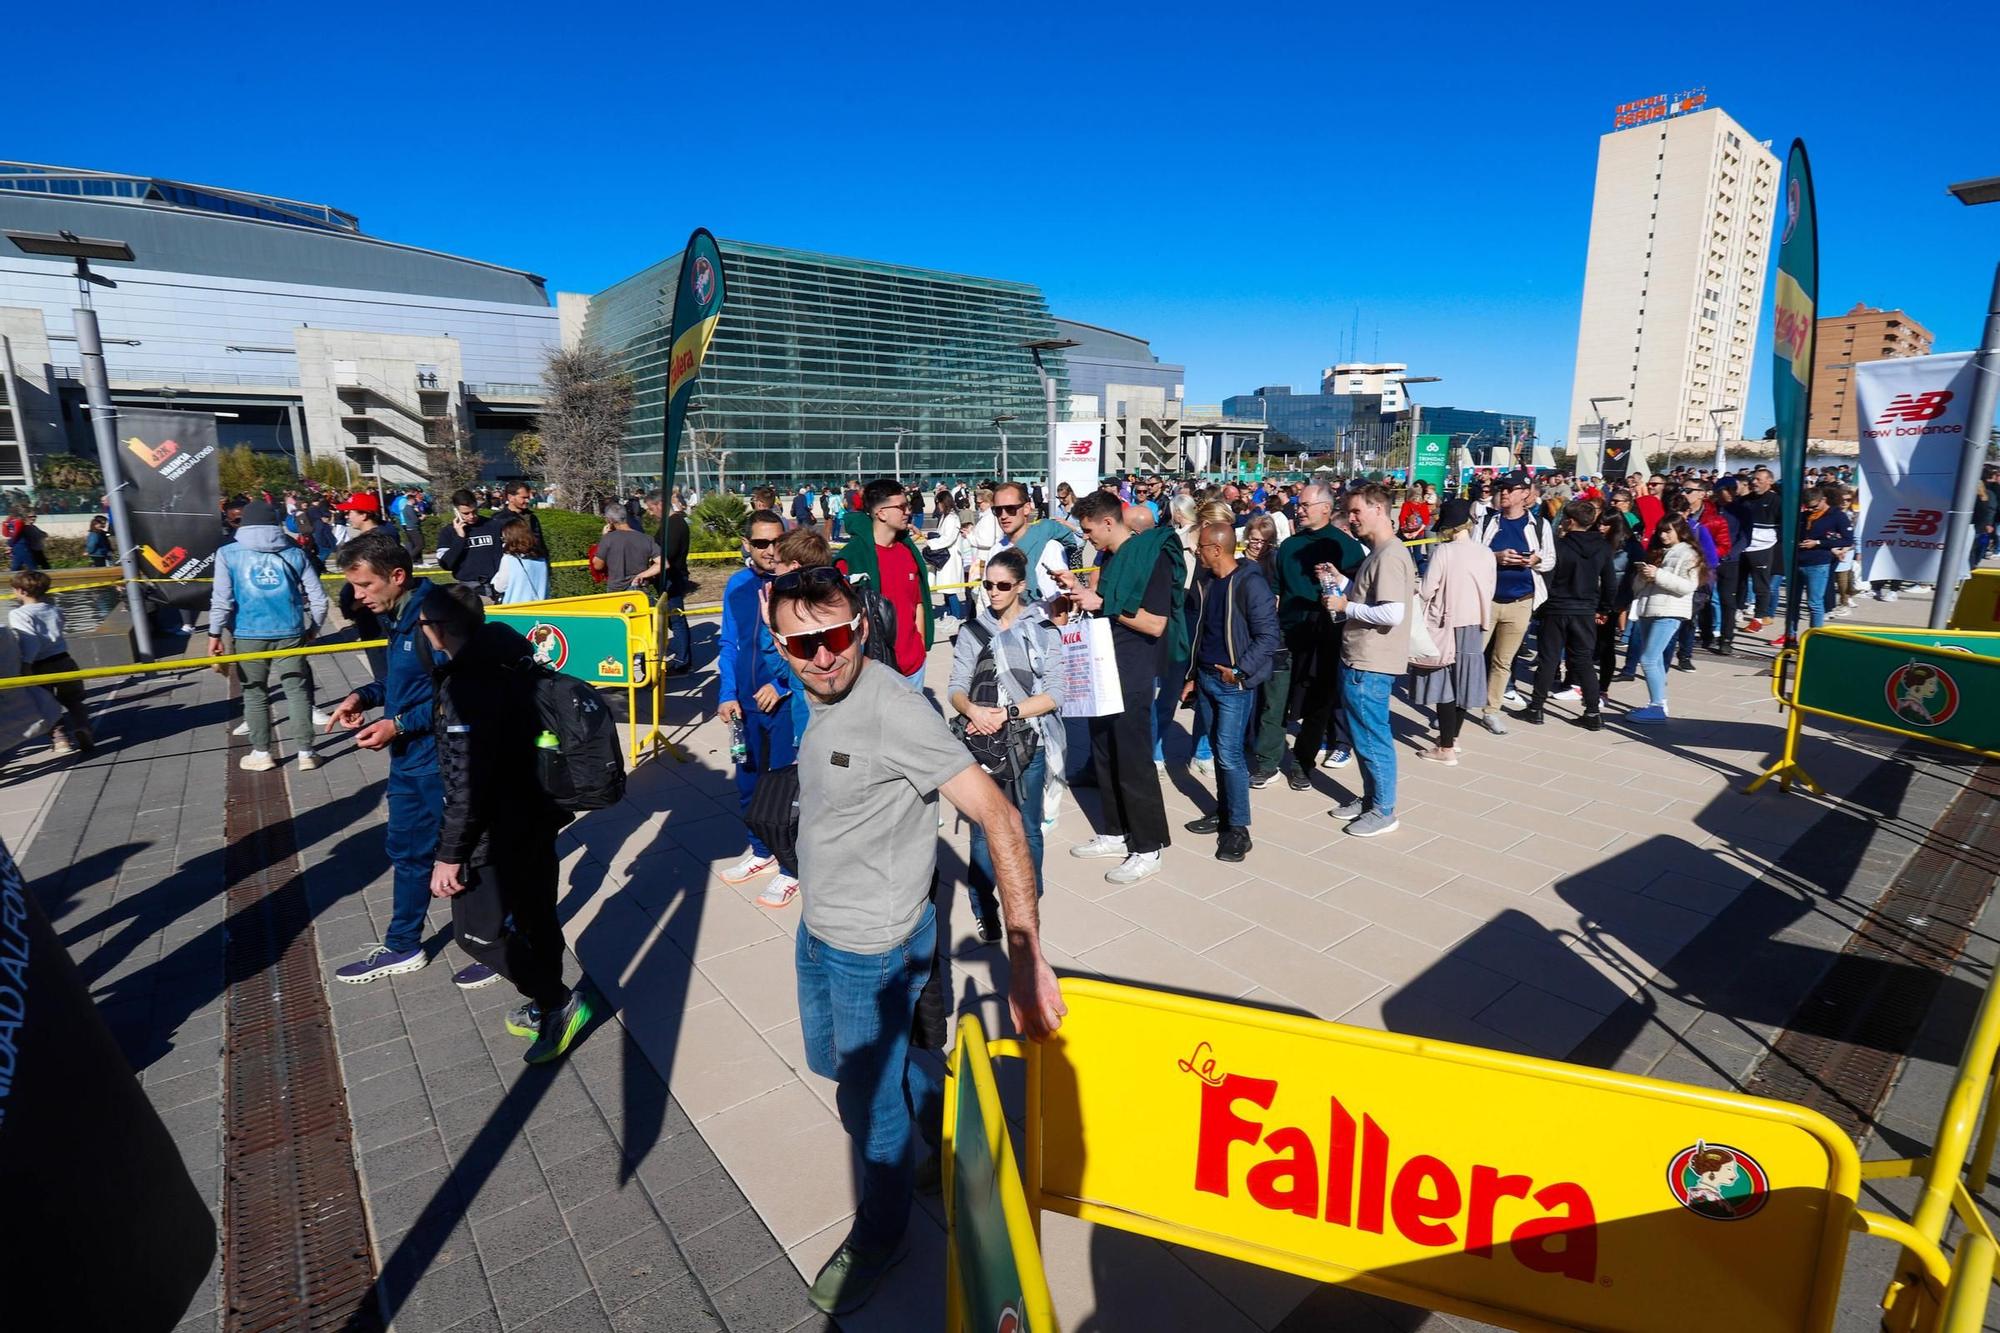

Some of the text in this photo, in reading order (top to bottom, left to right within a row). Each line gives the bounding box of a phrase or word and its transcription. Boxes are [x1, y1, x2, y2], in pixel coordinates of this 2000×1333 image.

[1863, 424, 1962, 439] new balance
[159, 452, 191, 476] VALENCIA
[1866, 539, 1947, 551] new balanc
[1178, 1041, 1226, 1085] La
[1195, 1073, 1598, 1283] Fallera
